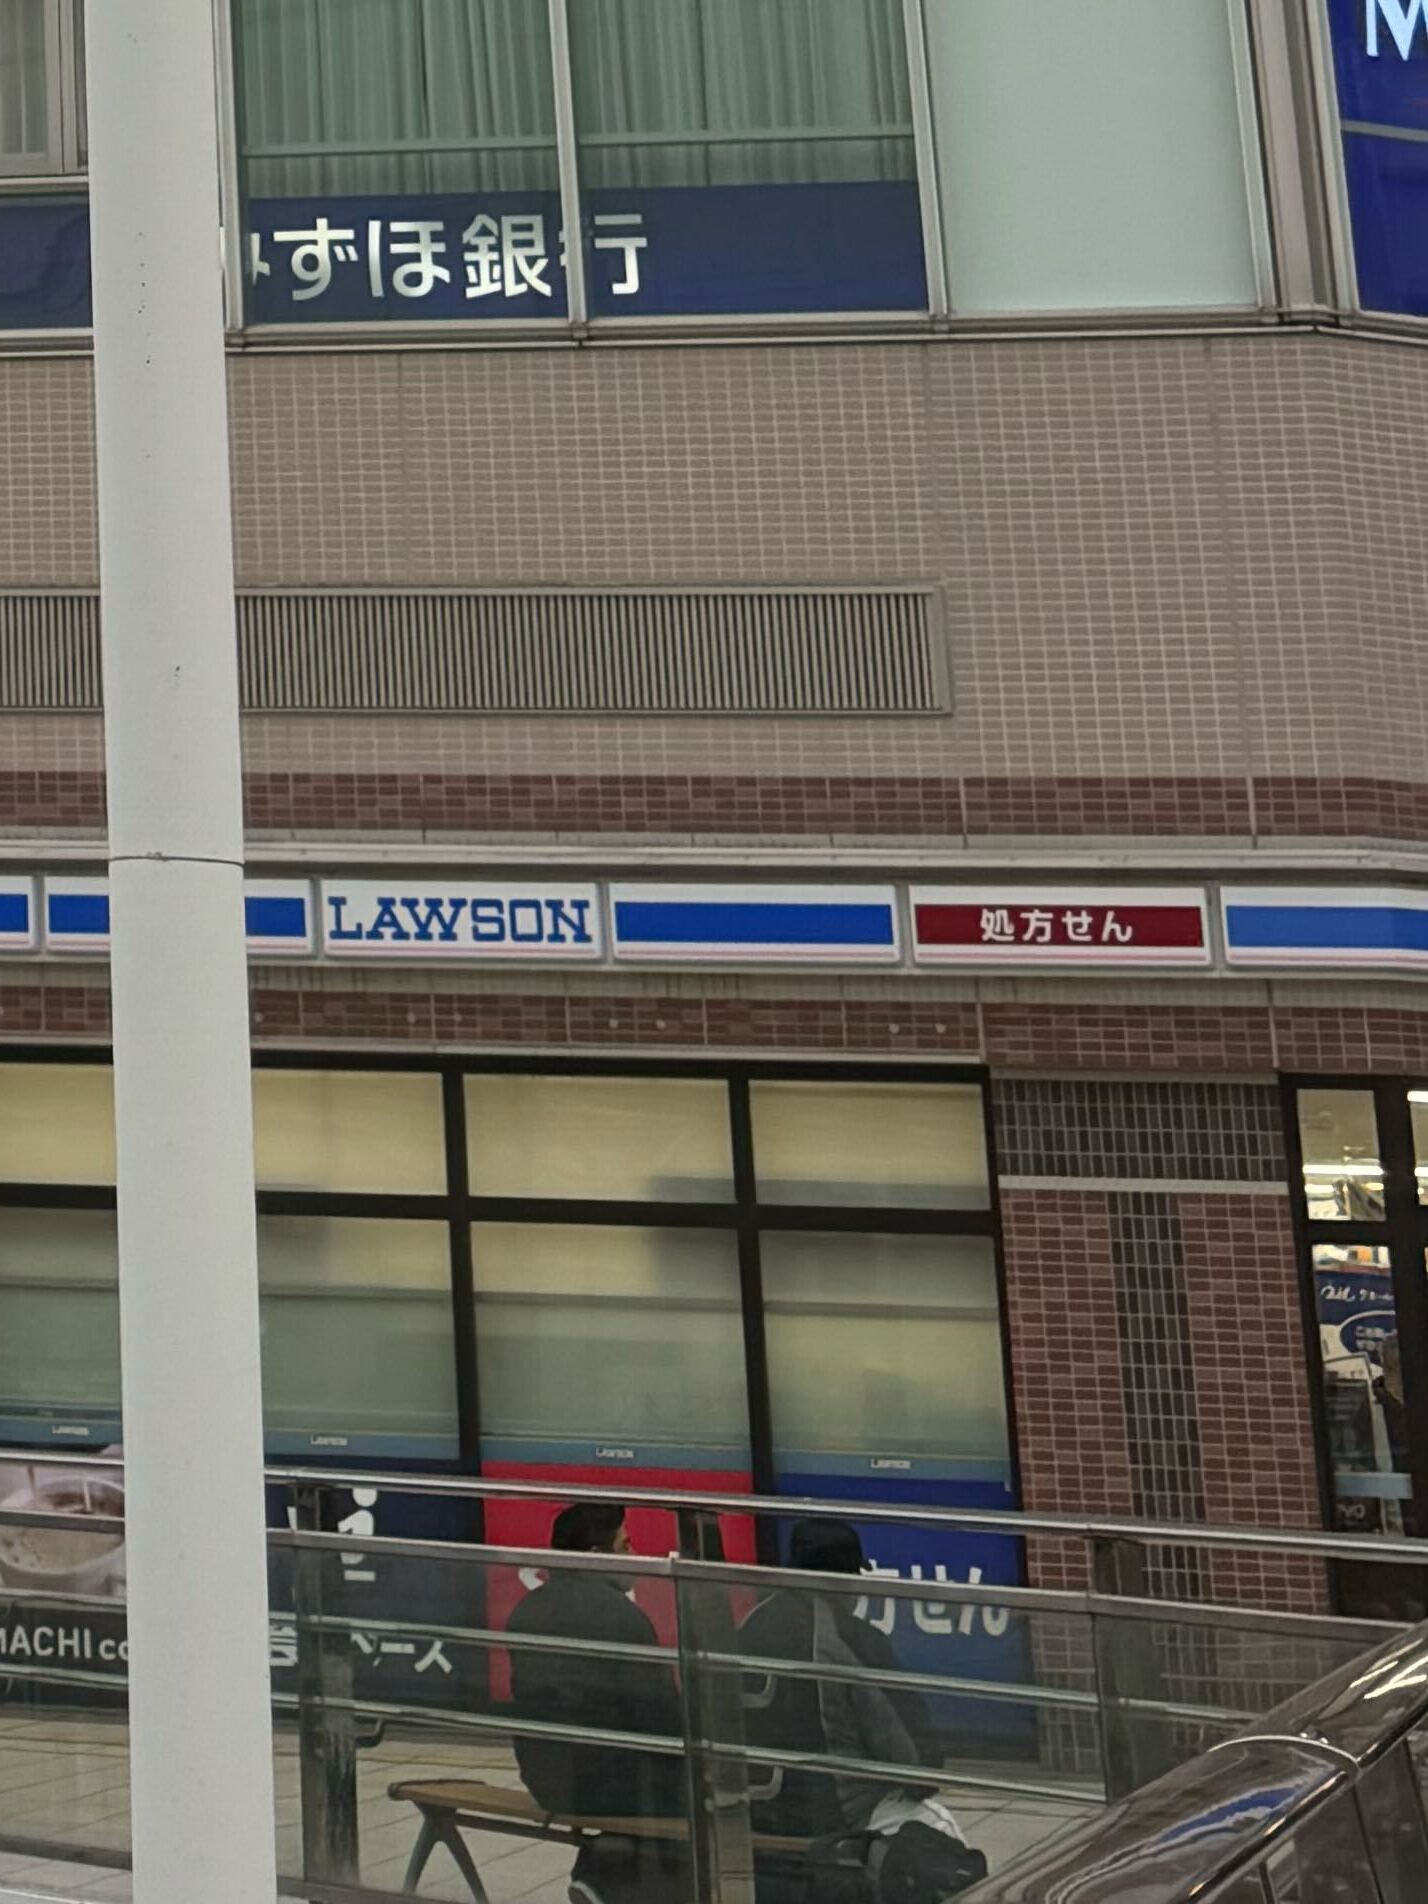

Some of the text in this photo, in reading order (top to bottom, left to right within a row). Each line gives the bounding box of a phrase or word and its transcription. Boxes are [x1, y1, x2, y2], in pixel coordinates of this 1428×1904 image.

[327, 896, 592, 943] LAWSON
[979, 908, 1134, 945] 処方せん
